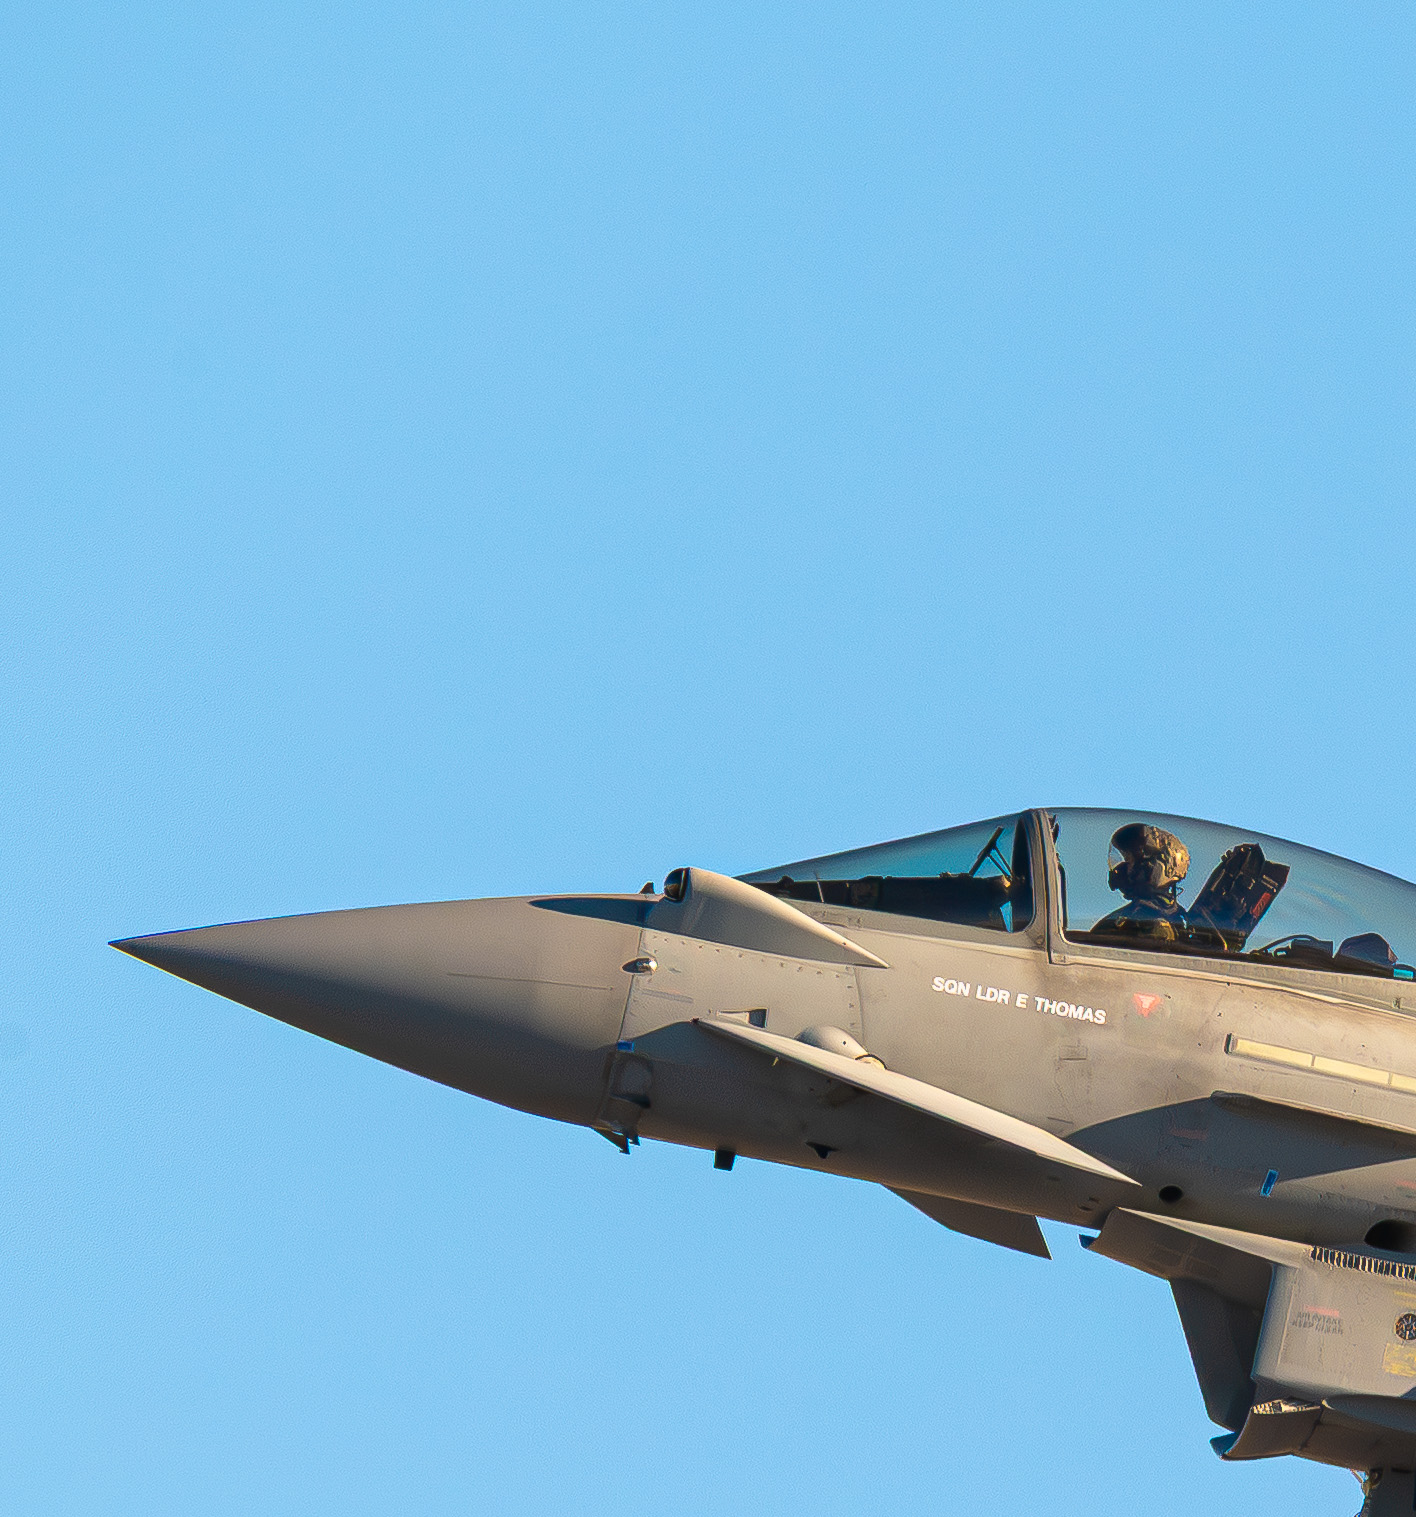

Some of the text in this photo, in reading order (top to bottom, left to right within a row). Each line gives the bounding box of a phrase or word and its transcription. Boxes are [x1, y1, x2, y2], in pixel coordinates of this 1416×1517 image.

[932, 976, 1107, 1025] SQN LDR E THOMAS
